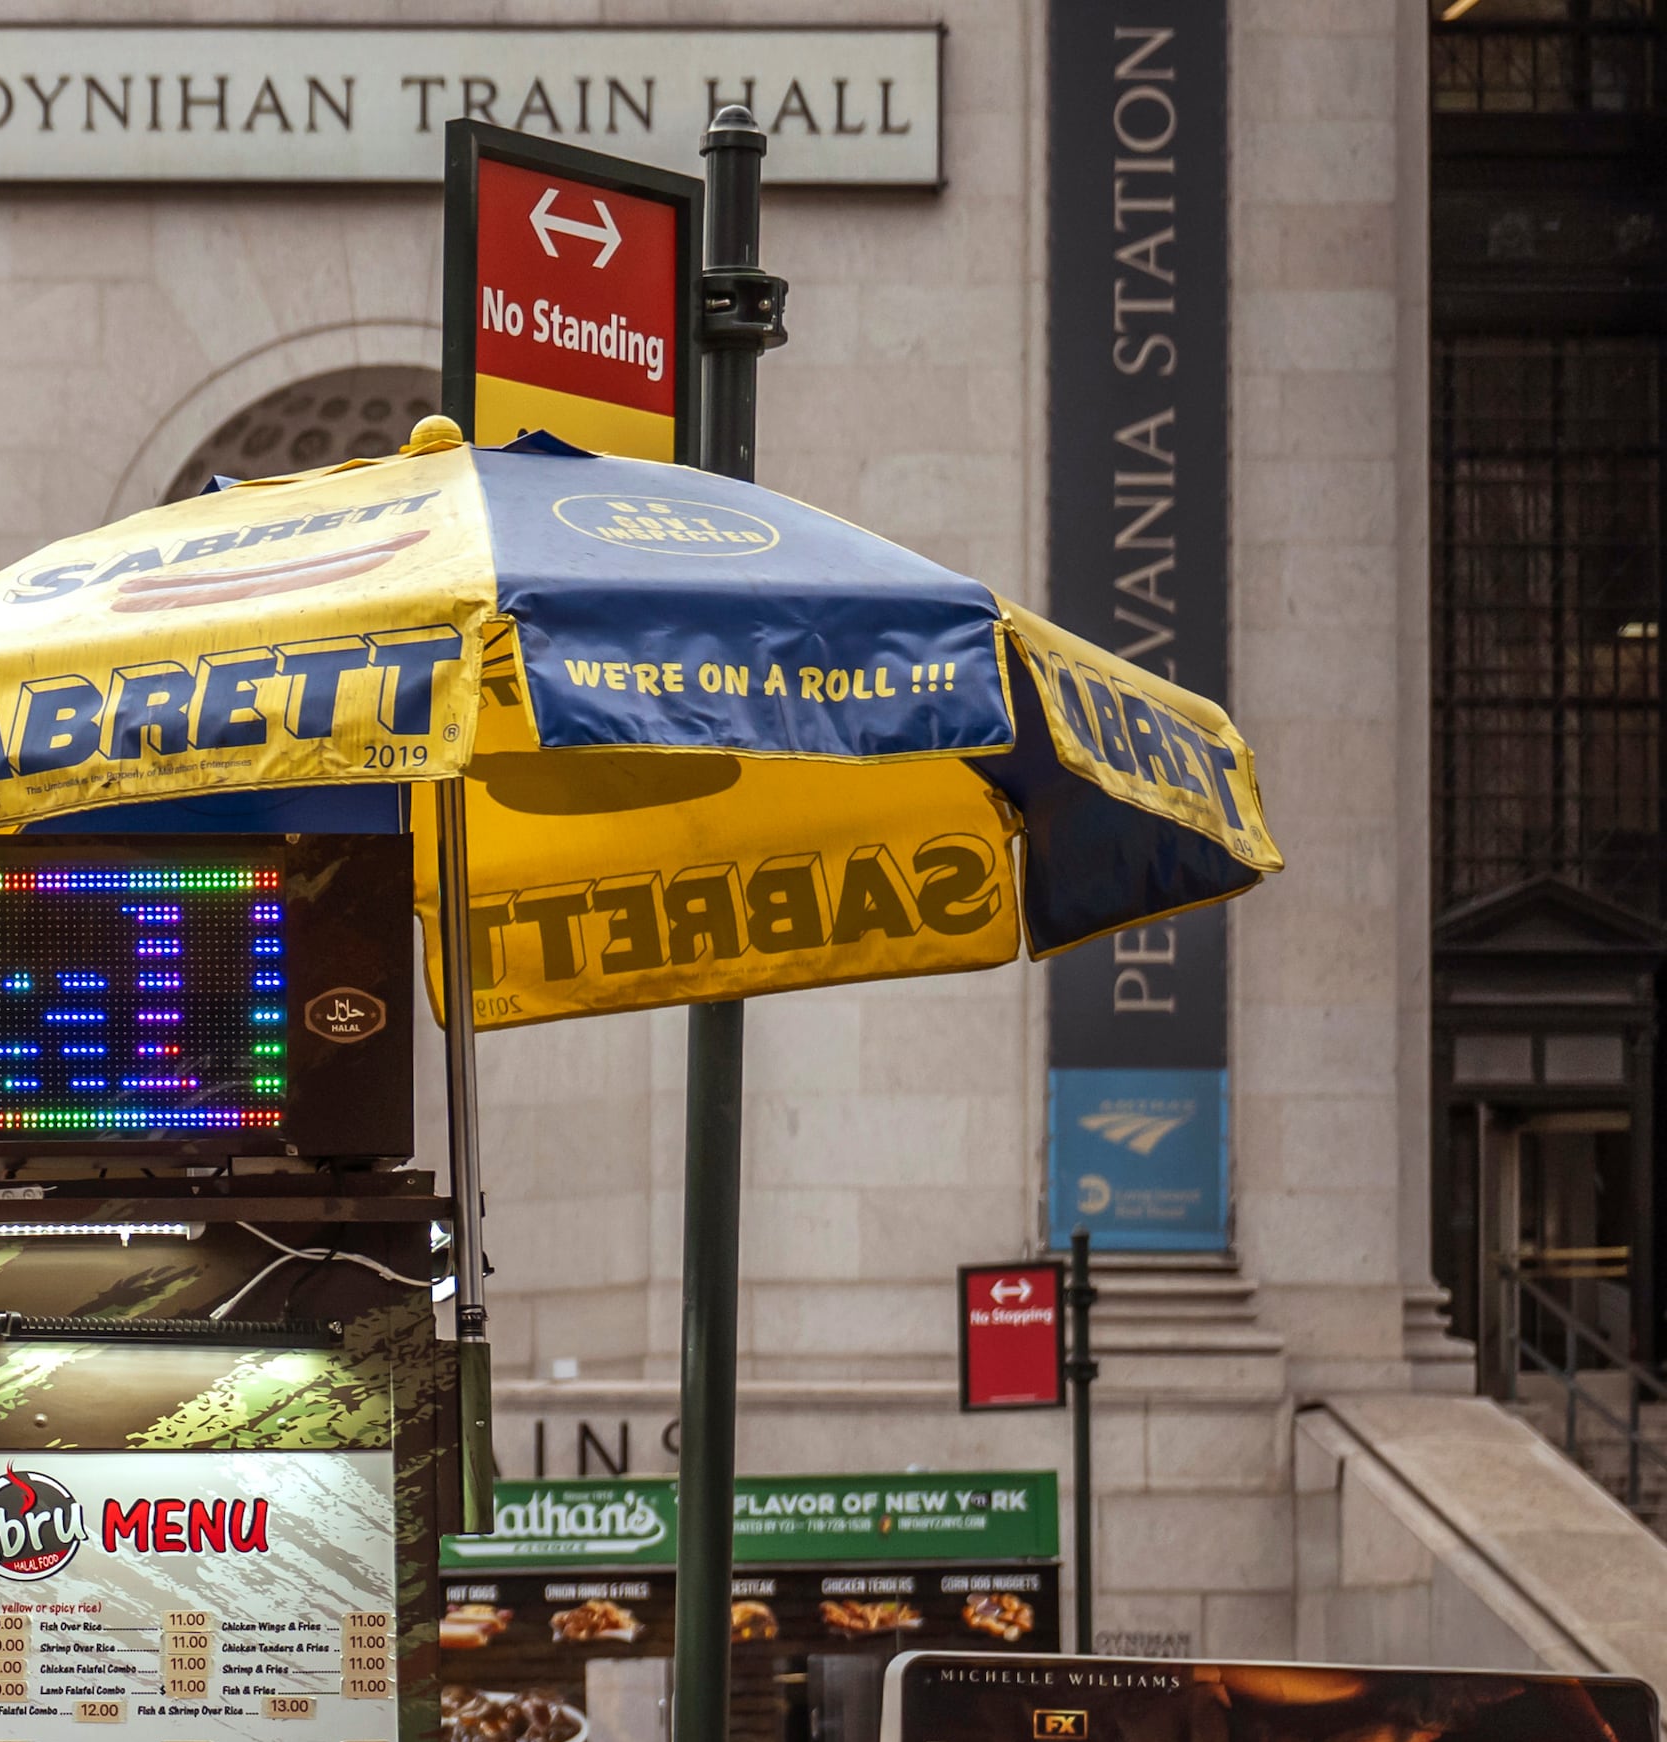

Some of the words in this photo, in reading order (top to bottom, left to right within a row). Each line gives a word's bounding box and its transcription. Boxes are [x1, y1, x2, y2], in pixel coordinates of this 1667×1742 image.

[401, 75, 657, 133] TRAIN
[1113, 24, 1177, 378] STATION
[481, 286, 523, 337] No
[532, 297, 665, 383] Standing
[3, 488, 442, 604] SABRETT
[595, 527, 768, 543] INSPECTED
[564, 658, 685, 693] WE'RE
[699, 663, 748, 696] ON
[764, 663, 789, 697] A
[801, 664, 896, 702] ROLL
[912, 662, 957, 694] !!!
[364, 744, 429, 772] 2019
[26, 785, 43, 796] This
[106, 767, 144, 784] Property
[147, 767, 157, 777] of
[200, 757, 253, 771] Enterprises
[326, 998, 365, 1022] حلال
[331, 1024, 361, 1033] HALAL
[970, 1310, 989, 1326] No
[991, 1306, 1053, 1327] Stopping
[458, 1490, 660, 1538] athan's
[733, 1493, 836, 1516] FLAVOR
[842, 1492, 879, 1514] OF
[886, 1490, 949, 1513] NEW
[101, 1497, 269, 1553] MENU
[13, 1557, 41, 1572] HALAL
[40, 1554, 60, 1568] FOOD
[545, 1584, 576, 1600] ONION
[578, 1583, 607, 1599] RINGS
[620, 1582, 649, 1598] FRIES
[821, 1577, 866, 1594] CHICKEN
[867, 1577, 915, 1593] TENDERS
[941, 1576, 967, 1592] CORN
[969, 1575, 990, 1592] DOG
[992, 1574, 1042, 1591] NUGGETS
[1, 1602, 34, 1614] yellow
[35, 1603, 47, 1613] or
[49, 1602, 76, 1616] spicy
[78, 1601, 103, 1614] rice)
[39, 1622, 58, 1632] Fish
[60, 1622, 81, 1632] Over
[82, 1622, 103, 1632] Rice
[169, 1613, 206, 1626] 11.00
[940, 1668, 1055, 1685] MICHELLE
[1068, 1673, 1181, 1689] WILLIAMS
[1044, 1716, 1076, 1734] FX
